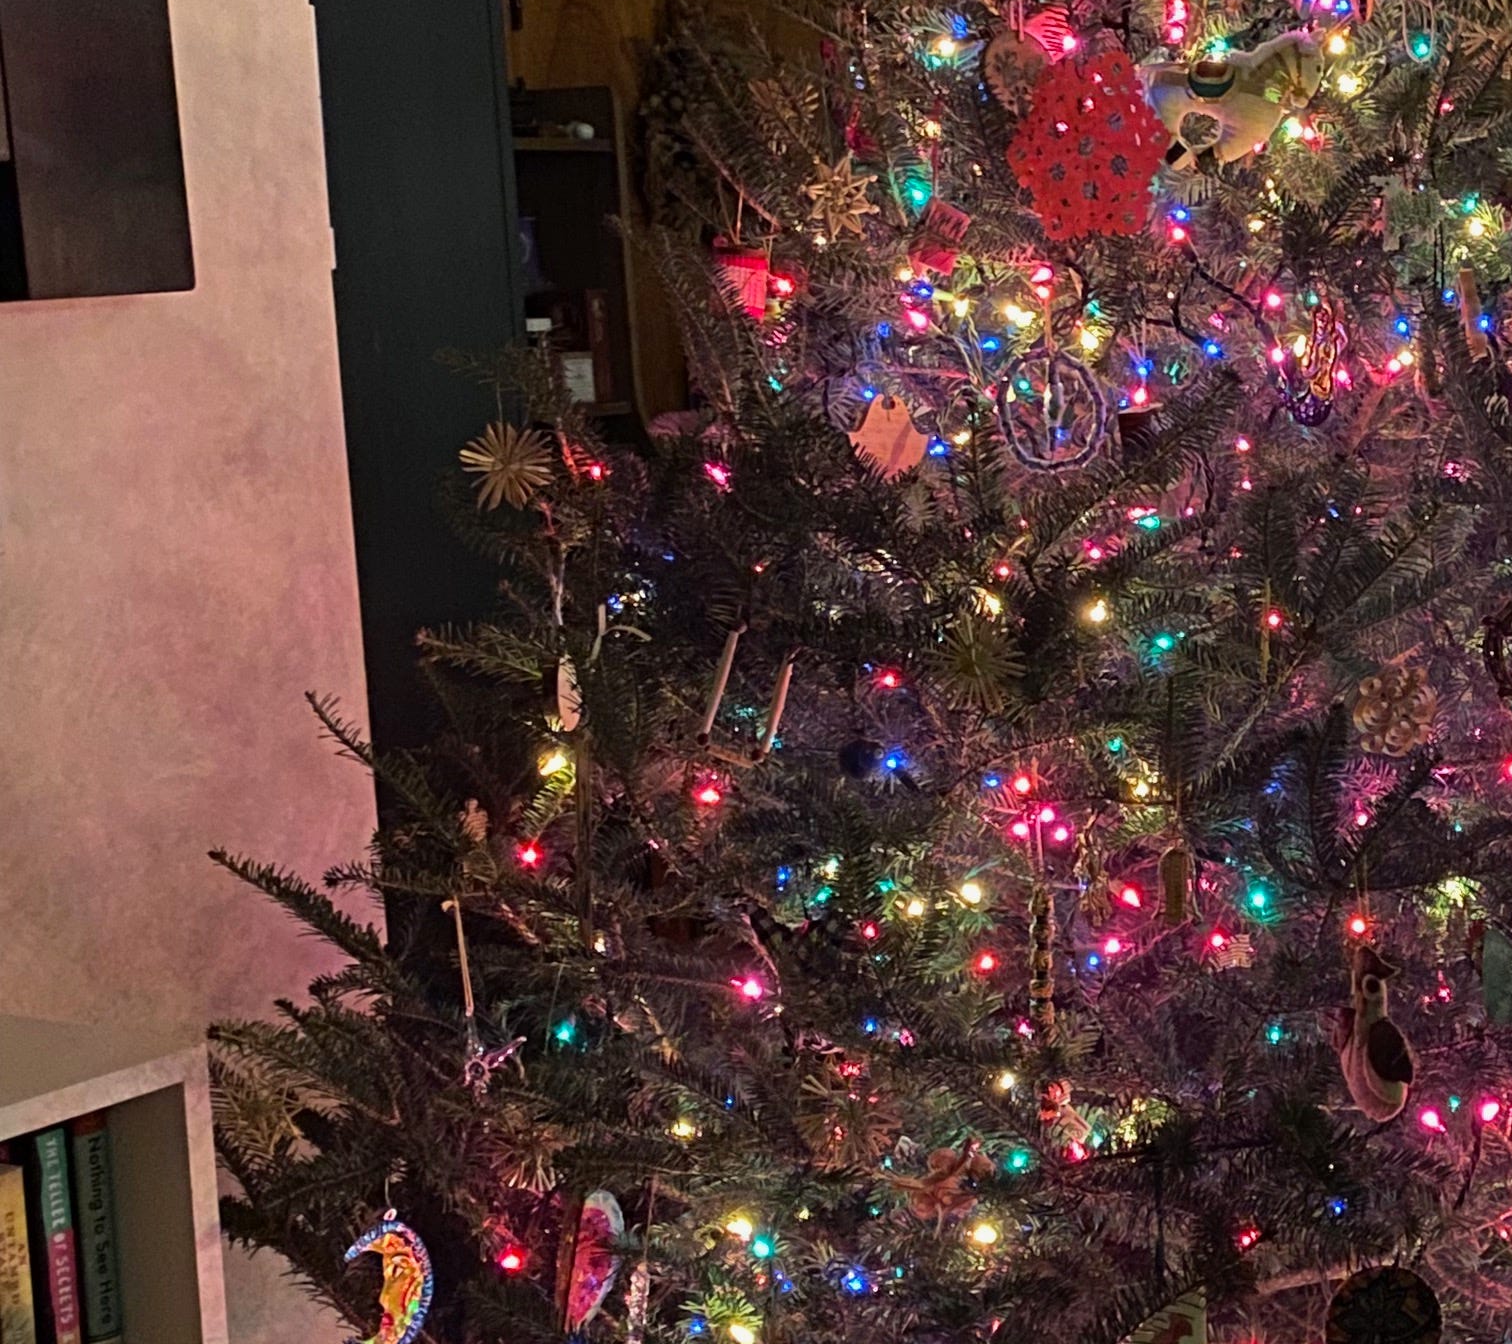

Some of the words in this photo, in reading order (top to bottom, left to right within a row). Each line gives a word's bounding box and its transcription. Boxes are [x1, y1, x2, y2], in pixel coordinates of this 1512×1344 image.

[45, 1138, 59, 1167] THE
[86, 1136, 107, 1211] Nothing
[47, 1175, 66, 1227] TELLER
[93, 1216, 106, 1234] to
[96, 1240, 110, 1275] See
[56, 1257, 73, 1325] SECRETS
[97, 1280, 114, 1325] Here
